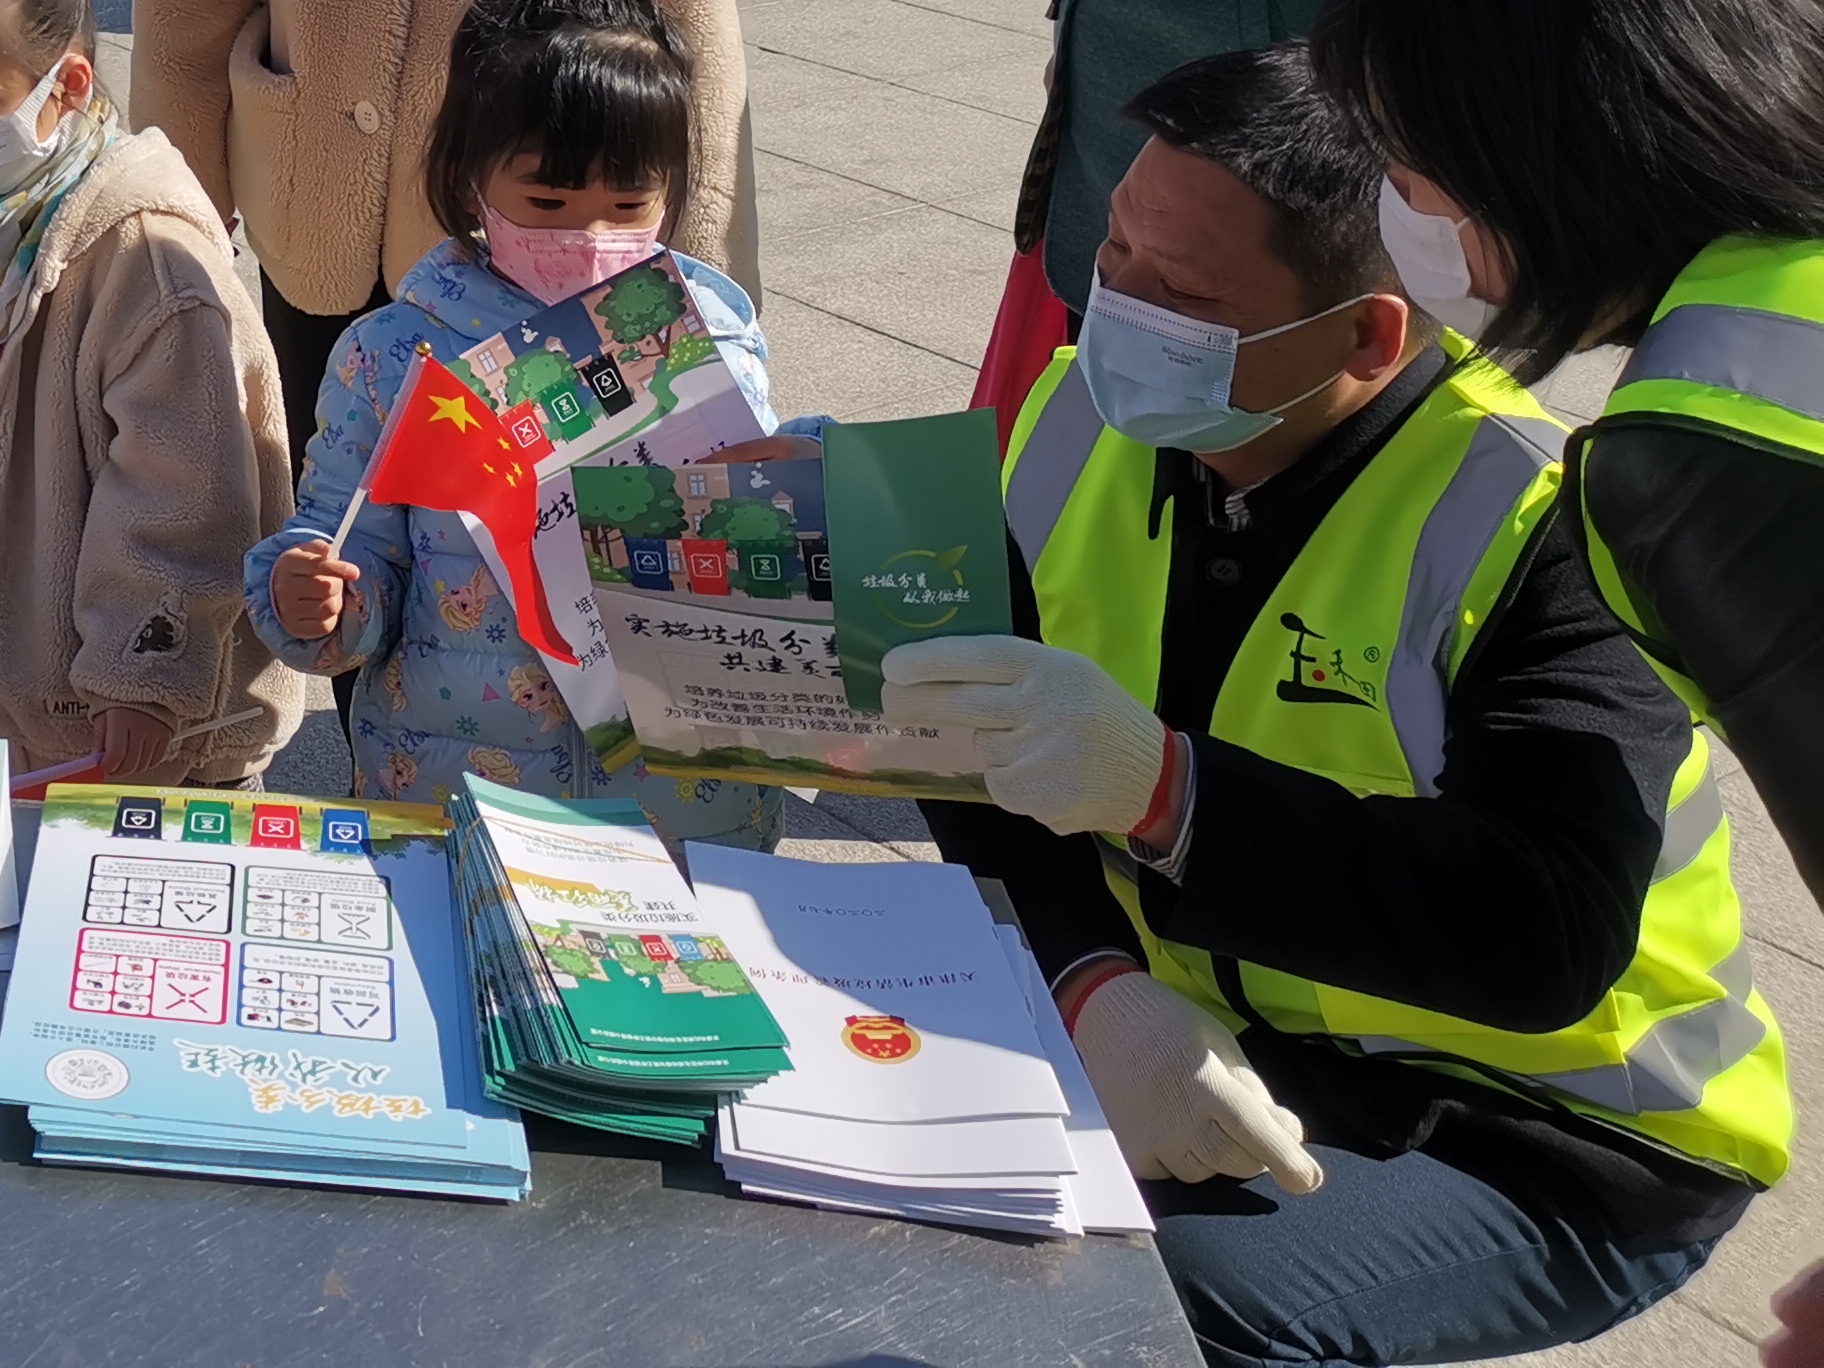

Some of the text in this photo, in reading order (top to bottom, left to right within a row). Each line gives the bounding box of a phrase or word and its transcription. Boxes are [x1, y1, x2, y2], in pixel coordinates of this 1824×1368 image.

[861, 571, 927, 588] 垃圾分类
[902, 588, 971, 606] 从我做起
[719, 651, 843, 679] 共建美
[691, 698, 881, 722] 为改善生活环境作
[247, 1077, 430, 1119] 垃圾分类
